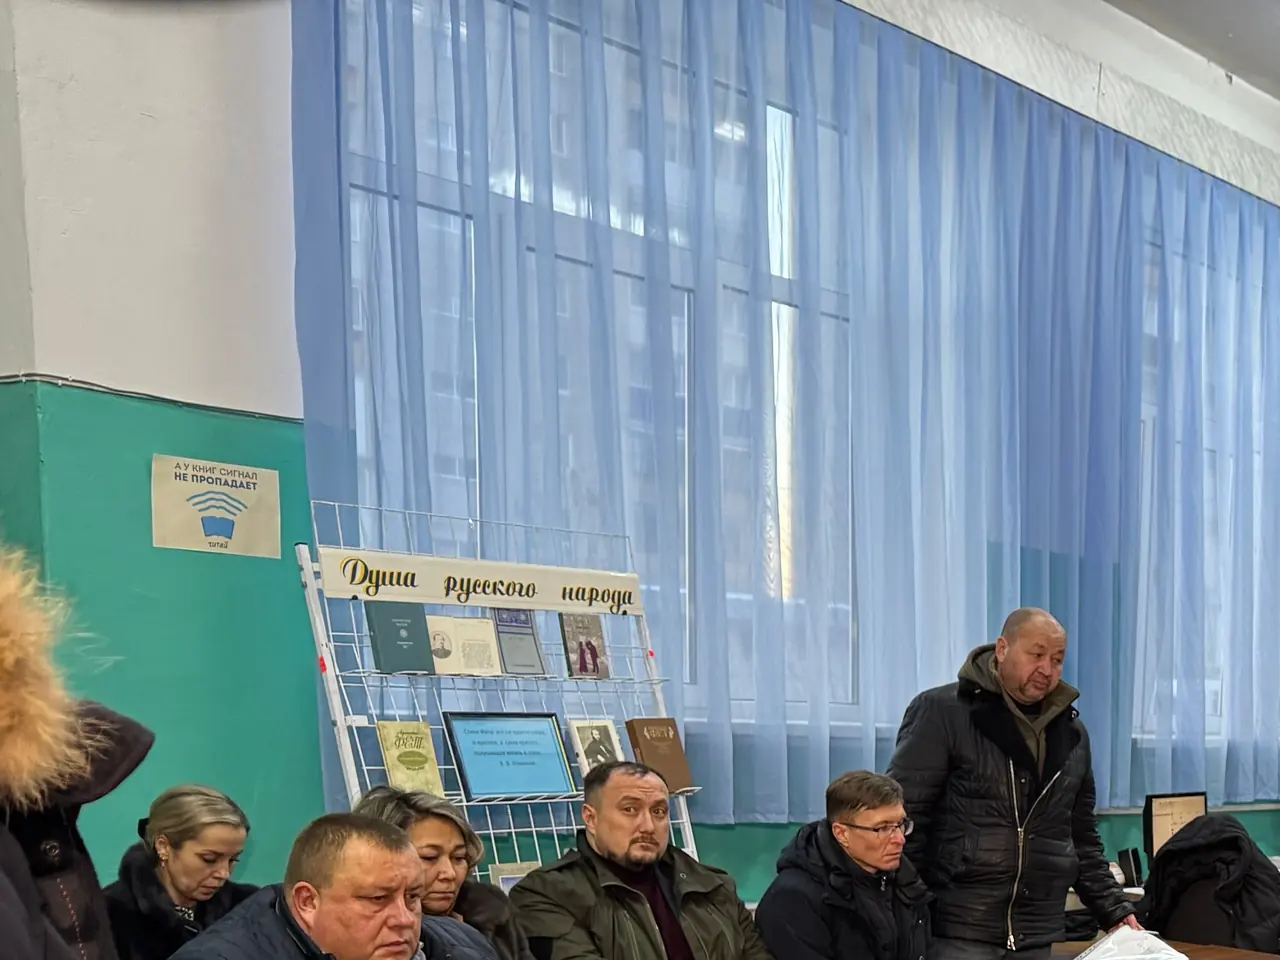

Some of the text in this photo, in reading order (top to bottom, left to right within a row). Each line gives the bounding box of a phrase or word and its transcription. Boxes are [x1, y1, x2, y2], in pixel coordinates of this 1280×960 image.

[174, 462, 182, 470] А
[192, 464, 217, 475] КНИГ
[219, 468, 258, 480] СИГНАЛ
[174, 472, 258, 490] НЕ ПРОПАДАЕТ
[339, 555, 635, 615] Душа русского народа
